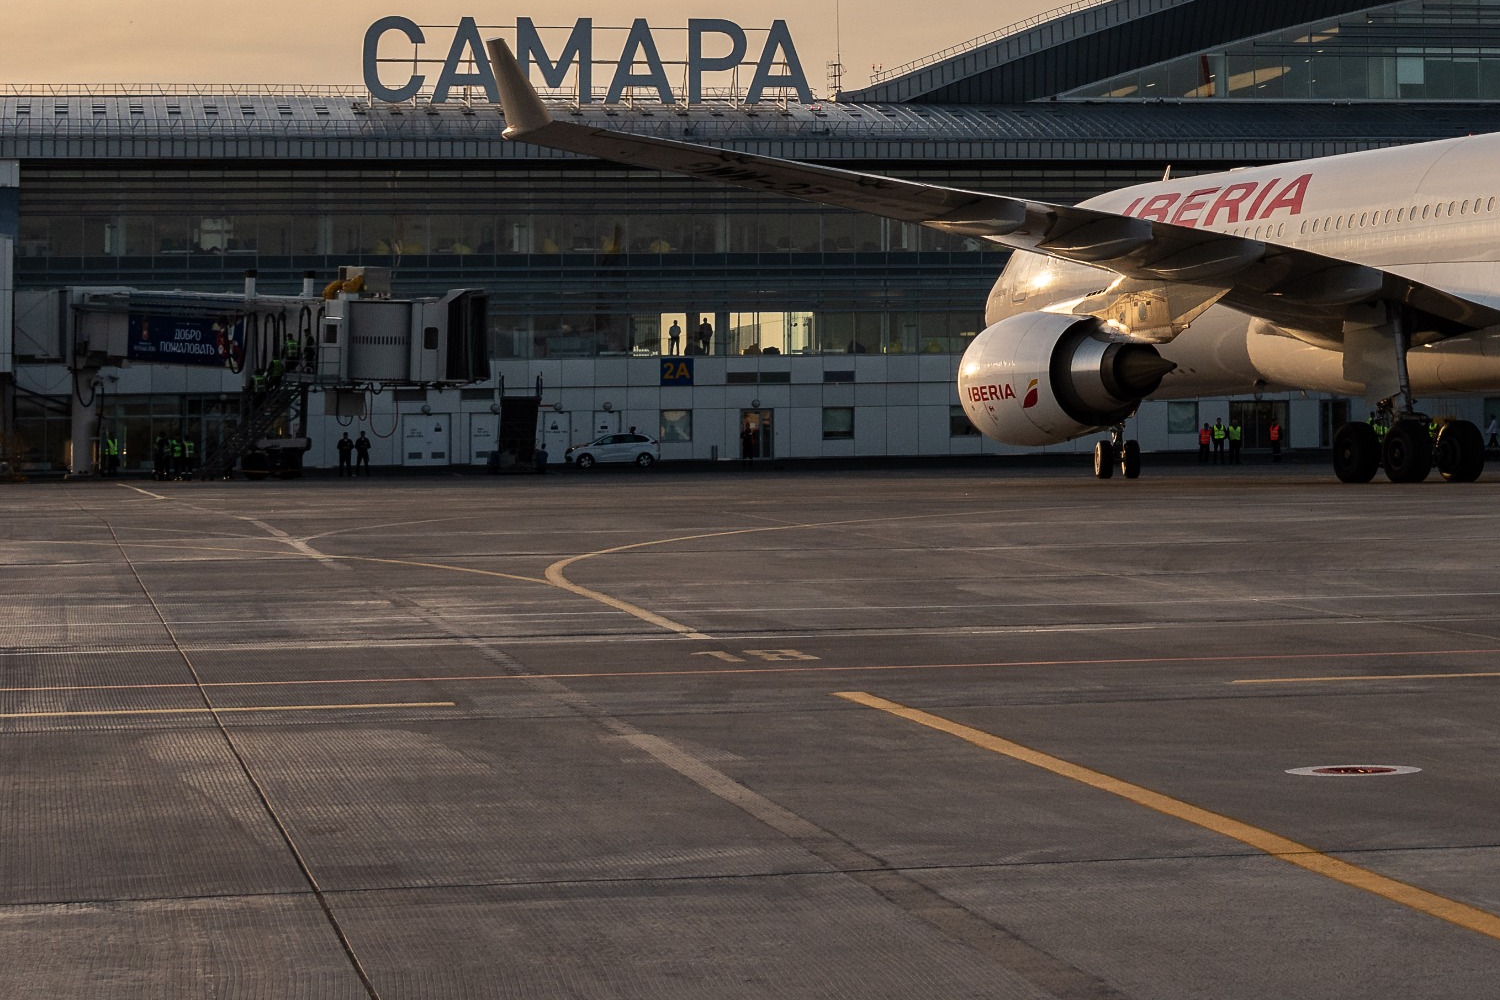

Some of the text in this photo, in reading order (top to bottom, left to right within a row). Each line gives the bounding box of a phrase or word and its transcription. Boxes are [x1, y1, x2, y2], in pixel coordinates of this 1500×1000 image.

[363, 16, 814, 104] САМАРА
[174, 329, 201, 340] ДОБРО
[160, 341, 215, 355] ПОЖАЛОВАТЬ
[663, 362, 690, 379] 2A
[968, 384, 1016, 402] IBERIA
